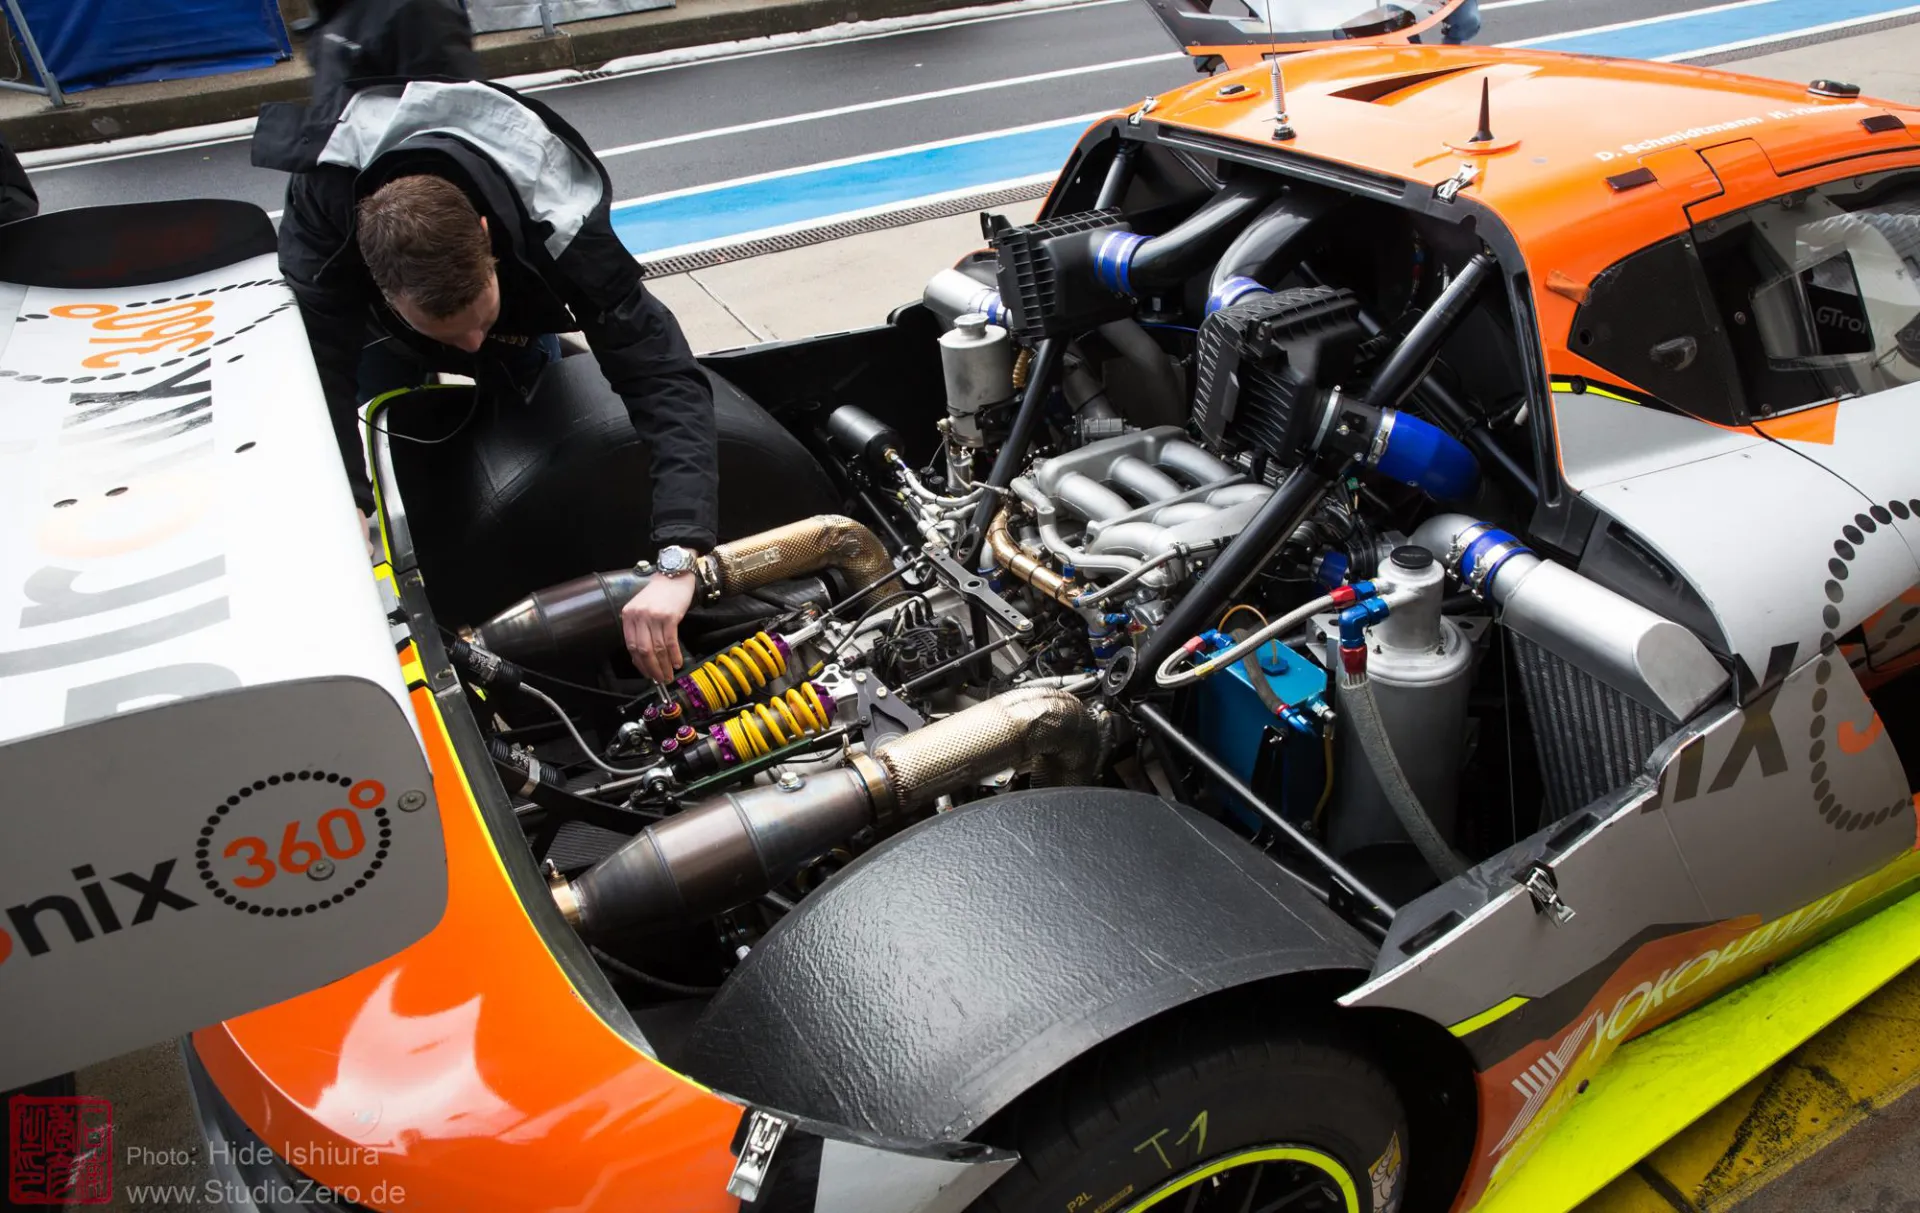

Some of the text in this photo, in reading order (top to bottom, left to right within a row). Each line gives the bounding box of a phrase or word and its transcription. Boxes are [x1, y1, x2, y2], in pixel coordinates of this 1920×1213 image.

[1622, 115, 1763, 153] Schmidtmann
[1815, 305, 1866, 334] GTro
[0, 858, 199, 965] nix
[1589, 884, 1854, 1060] YOKOHAMA
